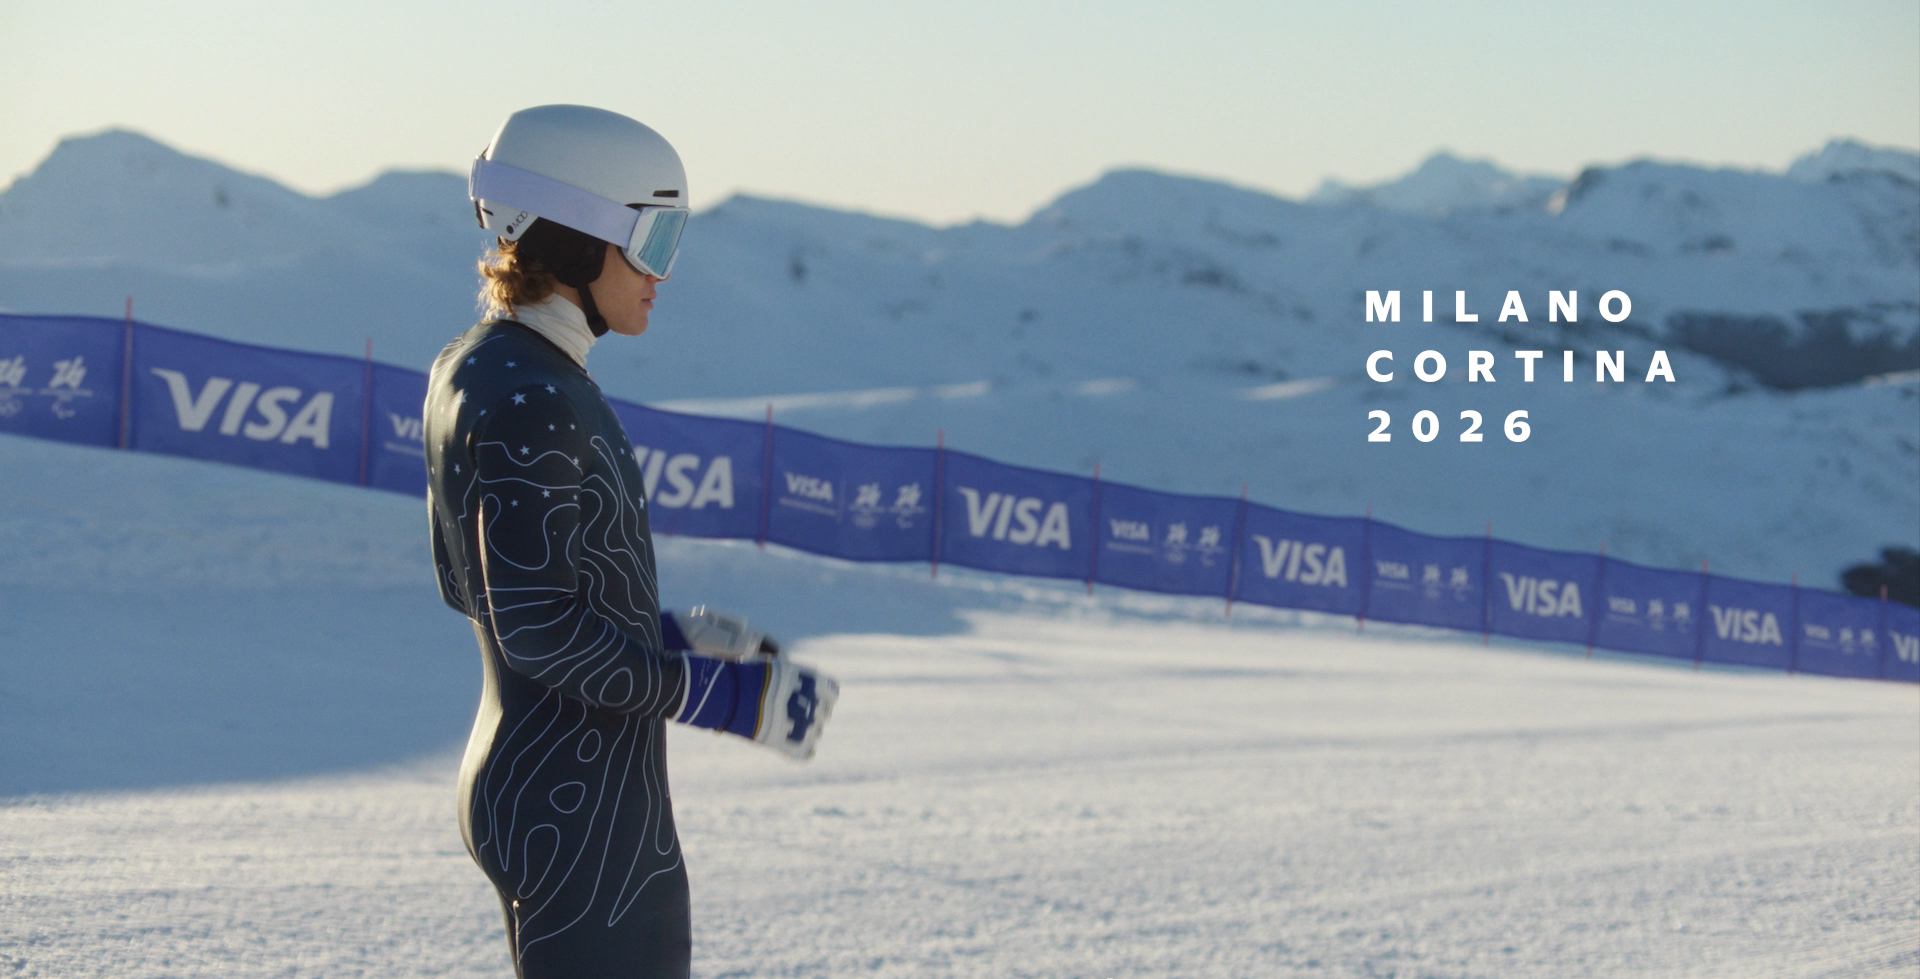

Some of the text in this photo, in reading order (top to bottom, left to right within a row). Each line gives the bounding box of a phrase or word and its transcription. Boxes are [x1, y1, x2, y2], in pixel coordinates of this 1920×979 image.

[150, 367, 334, 449] VISA
[386, 412, 424, 440] VI
[785, 471, 833, 502] VISA
[957, 486, 1071, 550] VISA
[1252, 534, 1348, 588] VISA
[1500, 572, 1583, 619] VISA
[1710, 604, 1783, 646] VISA
[1888, 630, 1920, 664] VI
